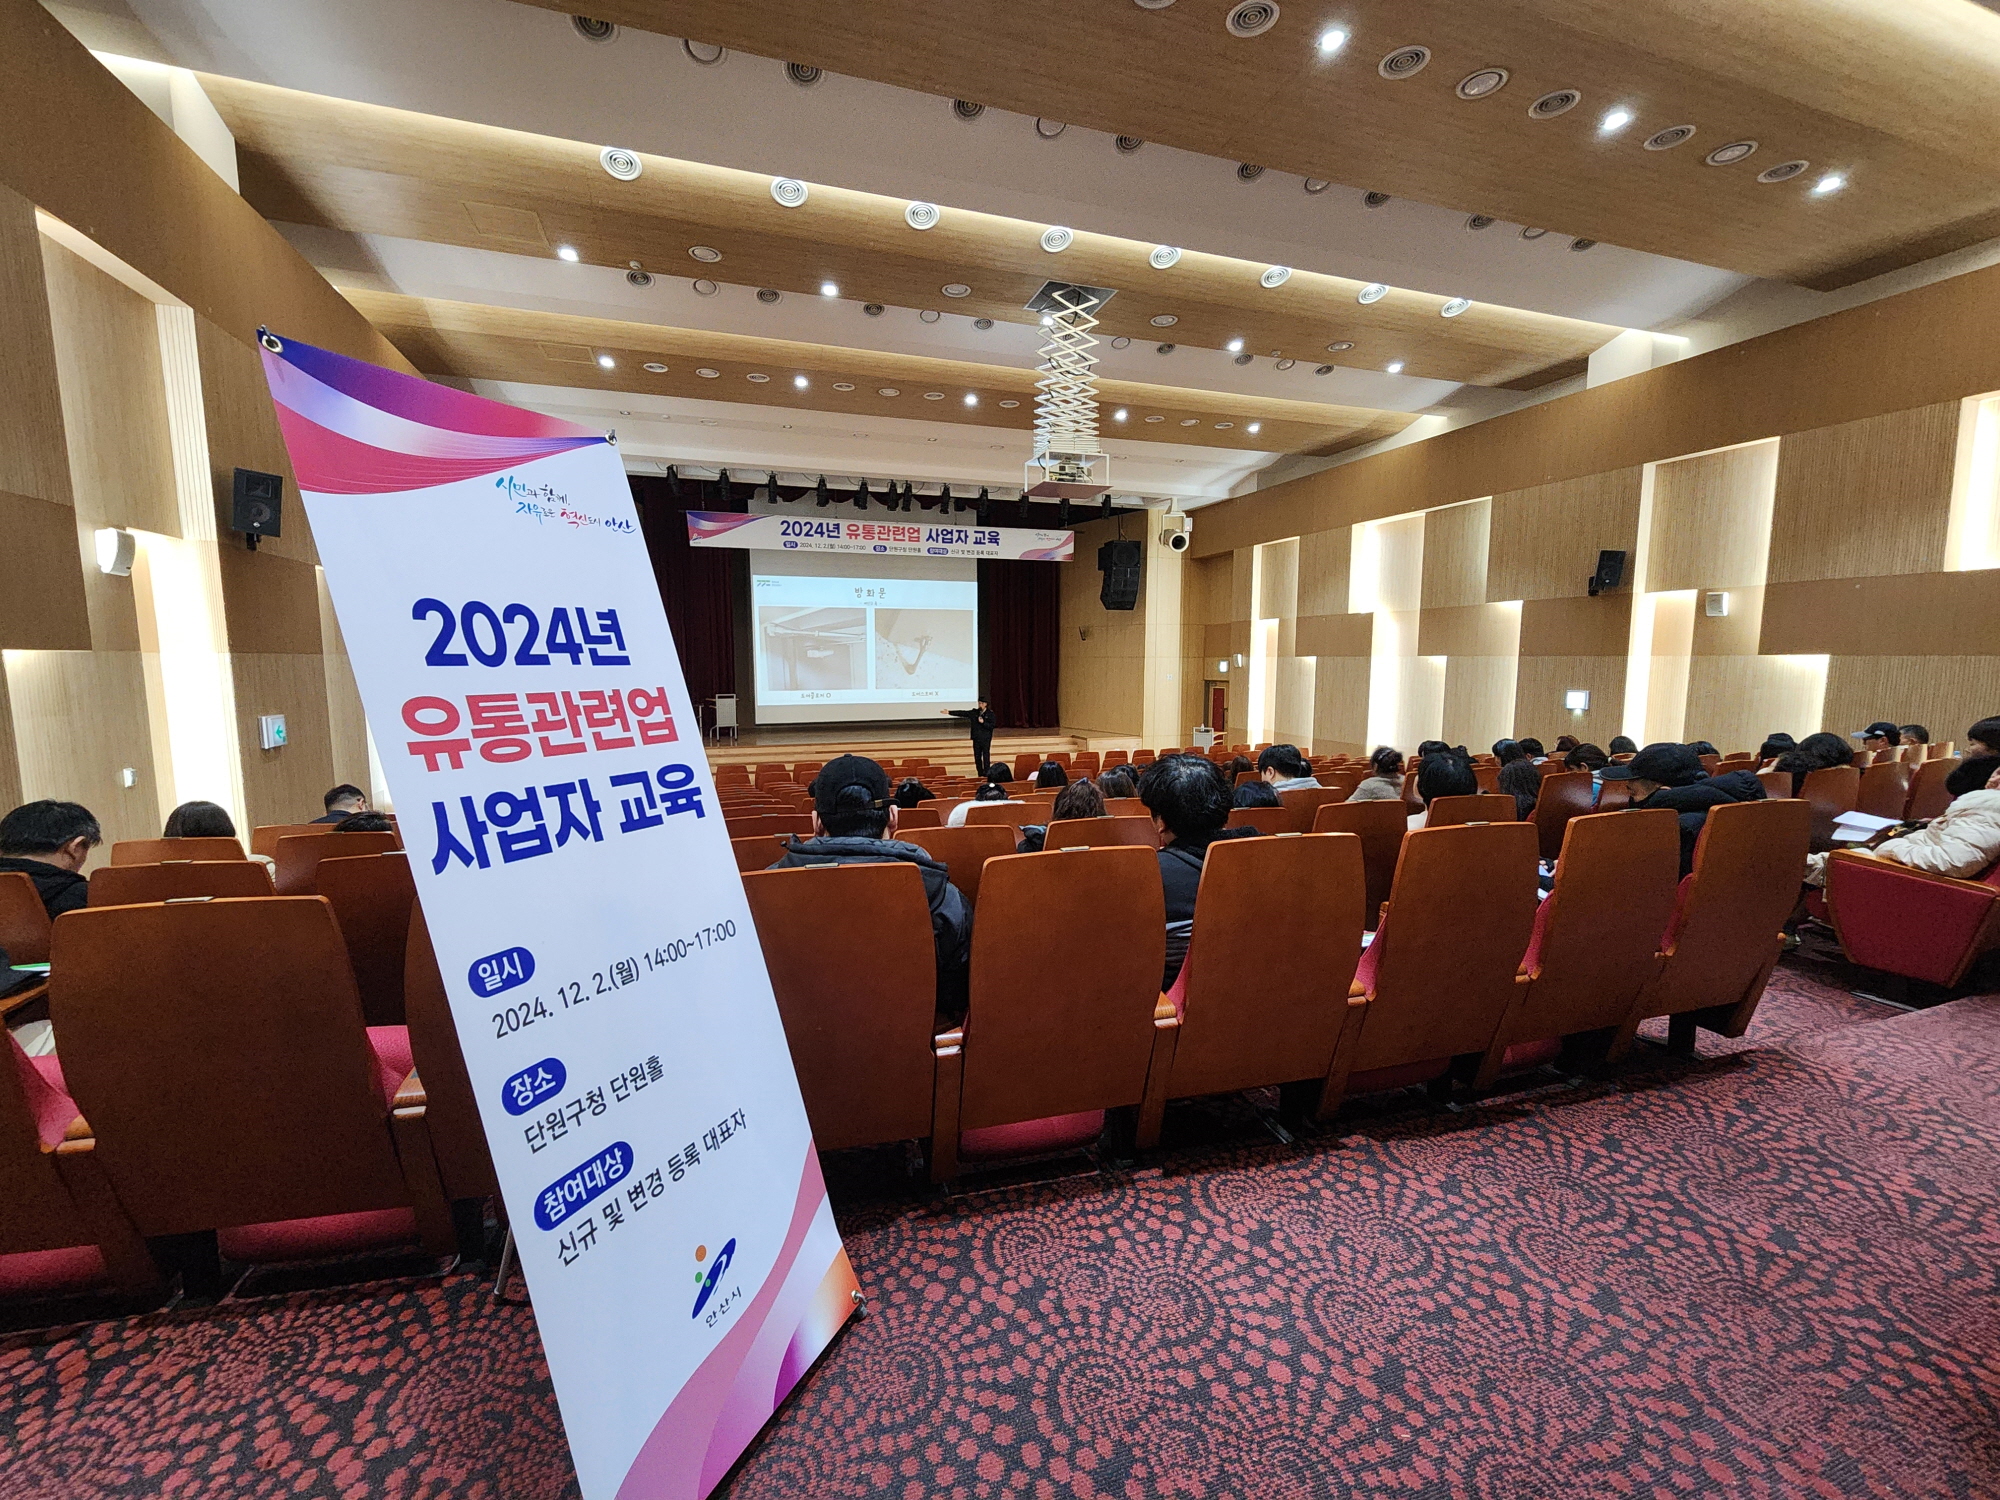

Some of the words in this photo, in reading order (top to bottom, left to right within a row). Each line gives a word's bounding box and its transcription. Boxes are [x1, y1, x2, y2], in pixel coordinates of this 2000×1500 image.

[495, 475, 540, 500] 시민과
[516, 501, 556, 525] 자유로운
[560, 508, 600, 529] 혁신도시
[605, 517, 636, 534] 안산
[780, 520, 841, 539] 2024년
[846, 523, 921, 543] 유통관련업
[925, 527, 969, 545] 사업자
[973, 530, 1000, 546] 교육
[412, 597, 631, 667] 2024년
[401, 686, 679, 772] 유통관련업
[431, 778, 604, 876] 사업자
[609, 763, 706, 834] 교육
[477, 952, 524, 992] 일시
[491, 996, 554, 1039] 2024.
[557, 981, 590, 1009] 12.
[592, 956, 640, 996] 2.(월)
[643, 919, 737, 972] 14:00~17:00
[510, 1066, 556, 1107] 장소
[523, 1086, 608, 1154] 단원구청
[610, 1054, 665, 1103] 단원홀
[543, 1147, 625, 1223] 참여대상
[557, 1217, 598, 1267] 신규
[602, 1197, 625, 1232] 및
[626, 1167, 665, 1213] 변경
[667, 1142, 701, 1182] 등록
[702, 1107, 747, 1153] 대표자
[705, 1286, 742, 1328] 안산시
